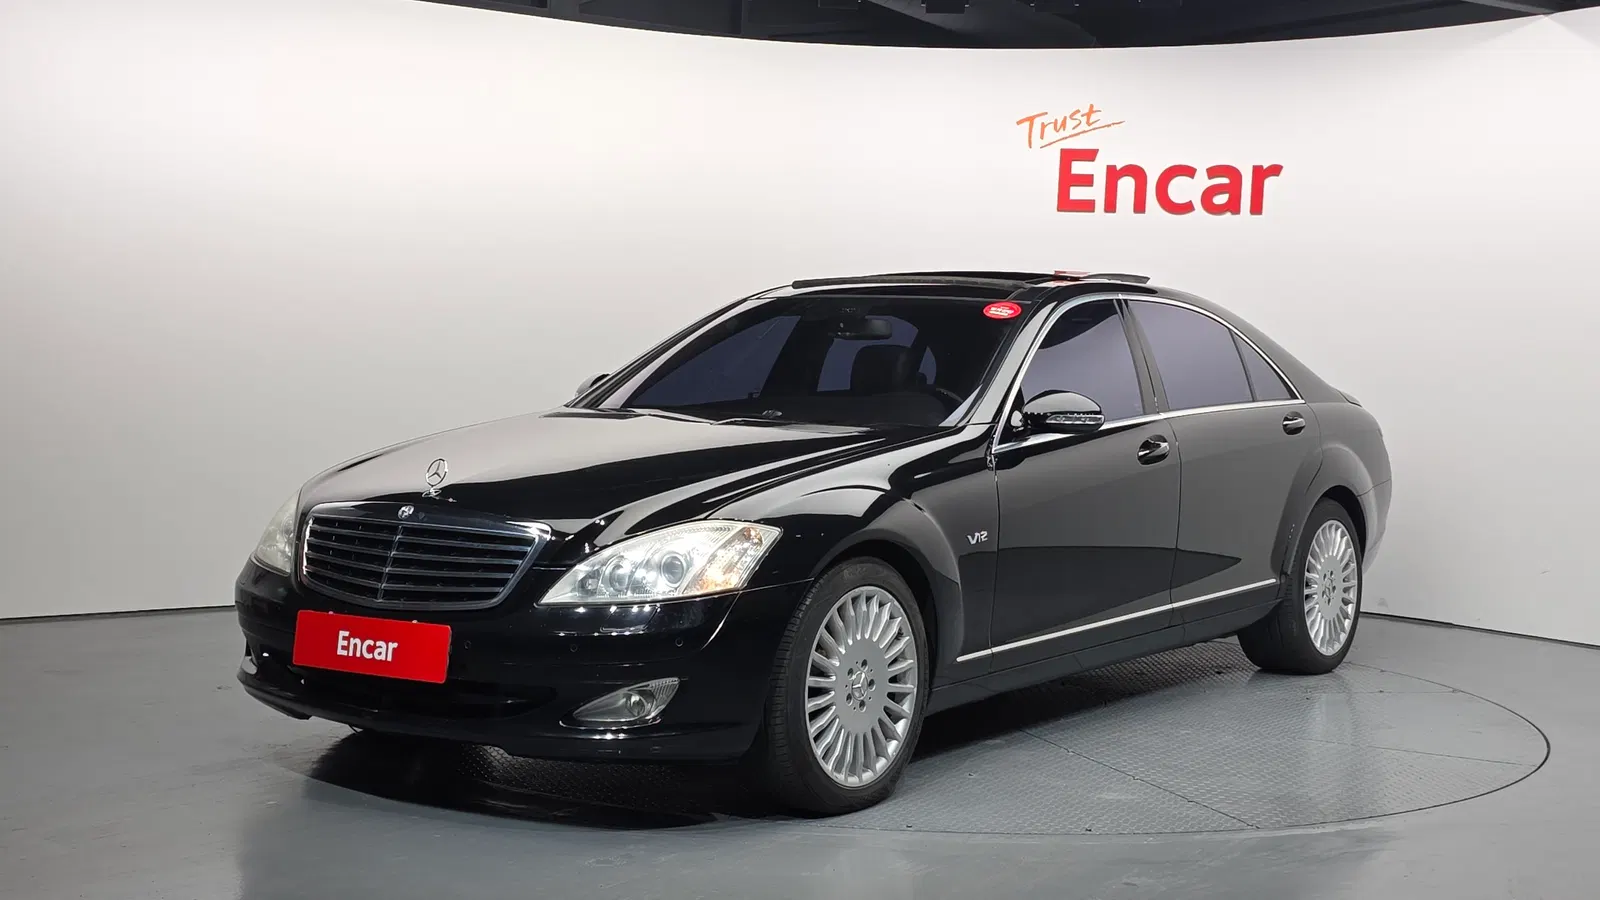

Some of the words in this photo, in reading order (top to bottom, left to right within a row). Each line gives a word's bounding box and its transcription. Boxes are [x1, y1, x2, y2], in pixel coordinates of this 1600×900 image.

[1016, 103, 1102, 149] Trust
[1057, 148, 1284, 216] Encar
[966, 530, 988, 545] V12
[336, 630, 398, 662] Encar
